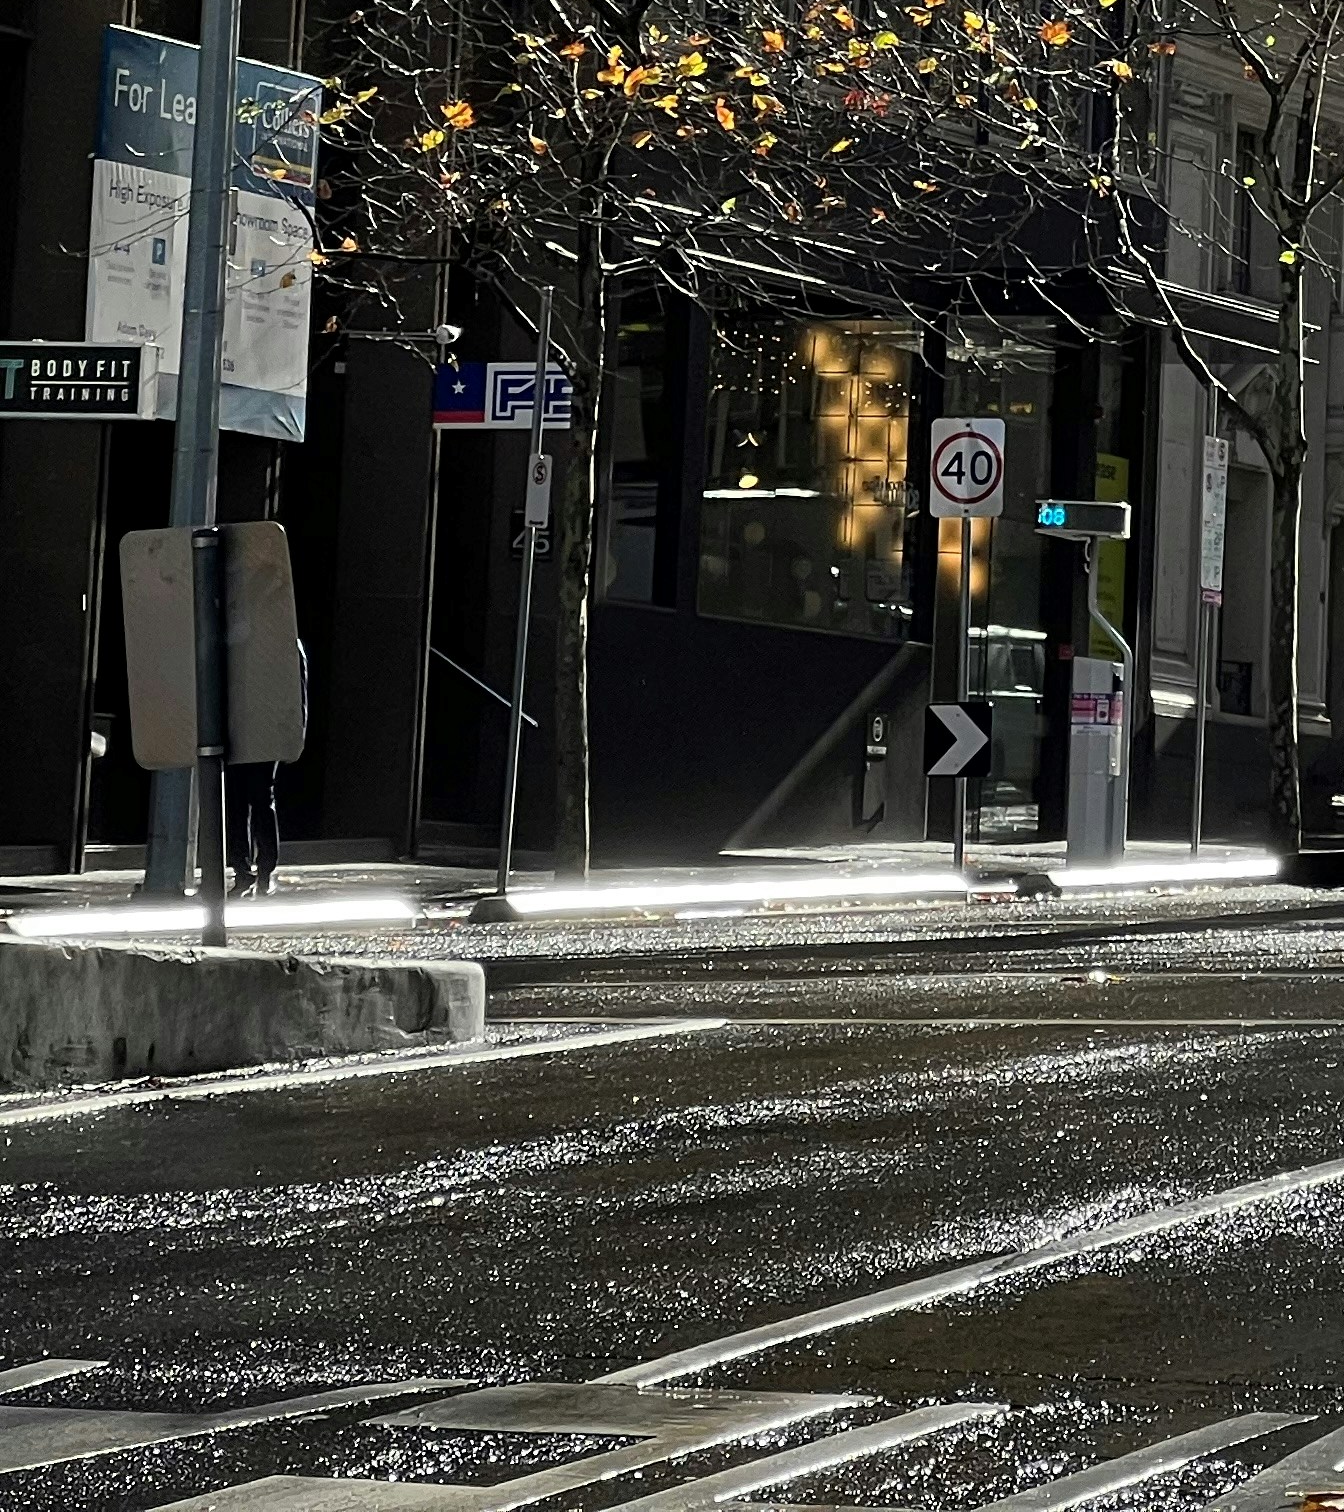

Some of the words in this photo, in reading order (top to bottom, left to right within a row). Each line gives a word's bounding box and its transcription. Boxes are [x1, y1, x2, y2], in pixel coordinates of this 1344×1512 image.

[114, 68, 153, 114] For
[160, 78, 197, 126] Lea
[110, 178, 134, 205] High
[281, 217, 308, 242] Space
[31, 359, 88, 377] BODY
[96, 360, 131, 377] FIT
[30, 387, 129, 402] TRAINING
[941, 451, 993, 485] 40
